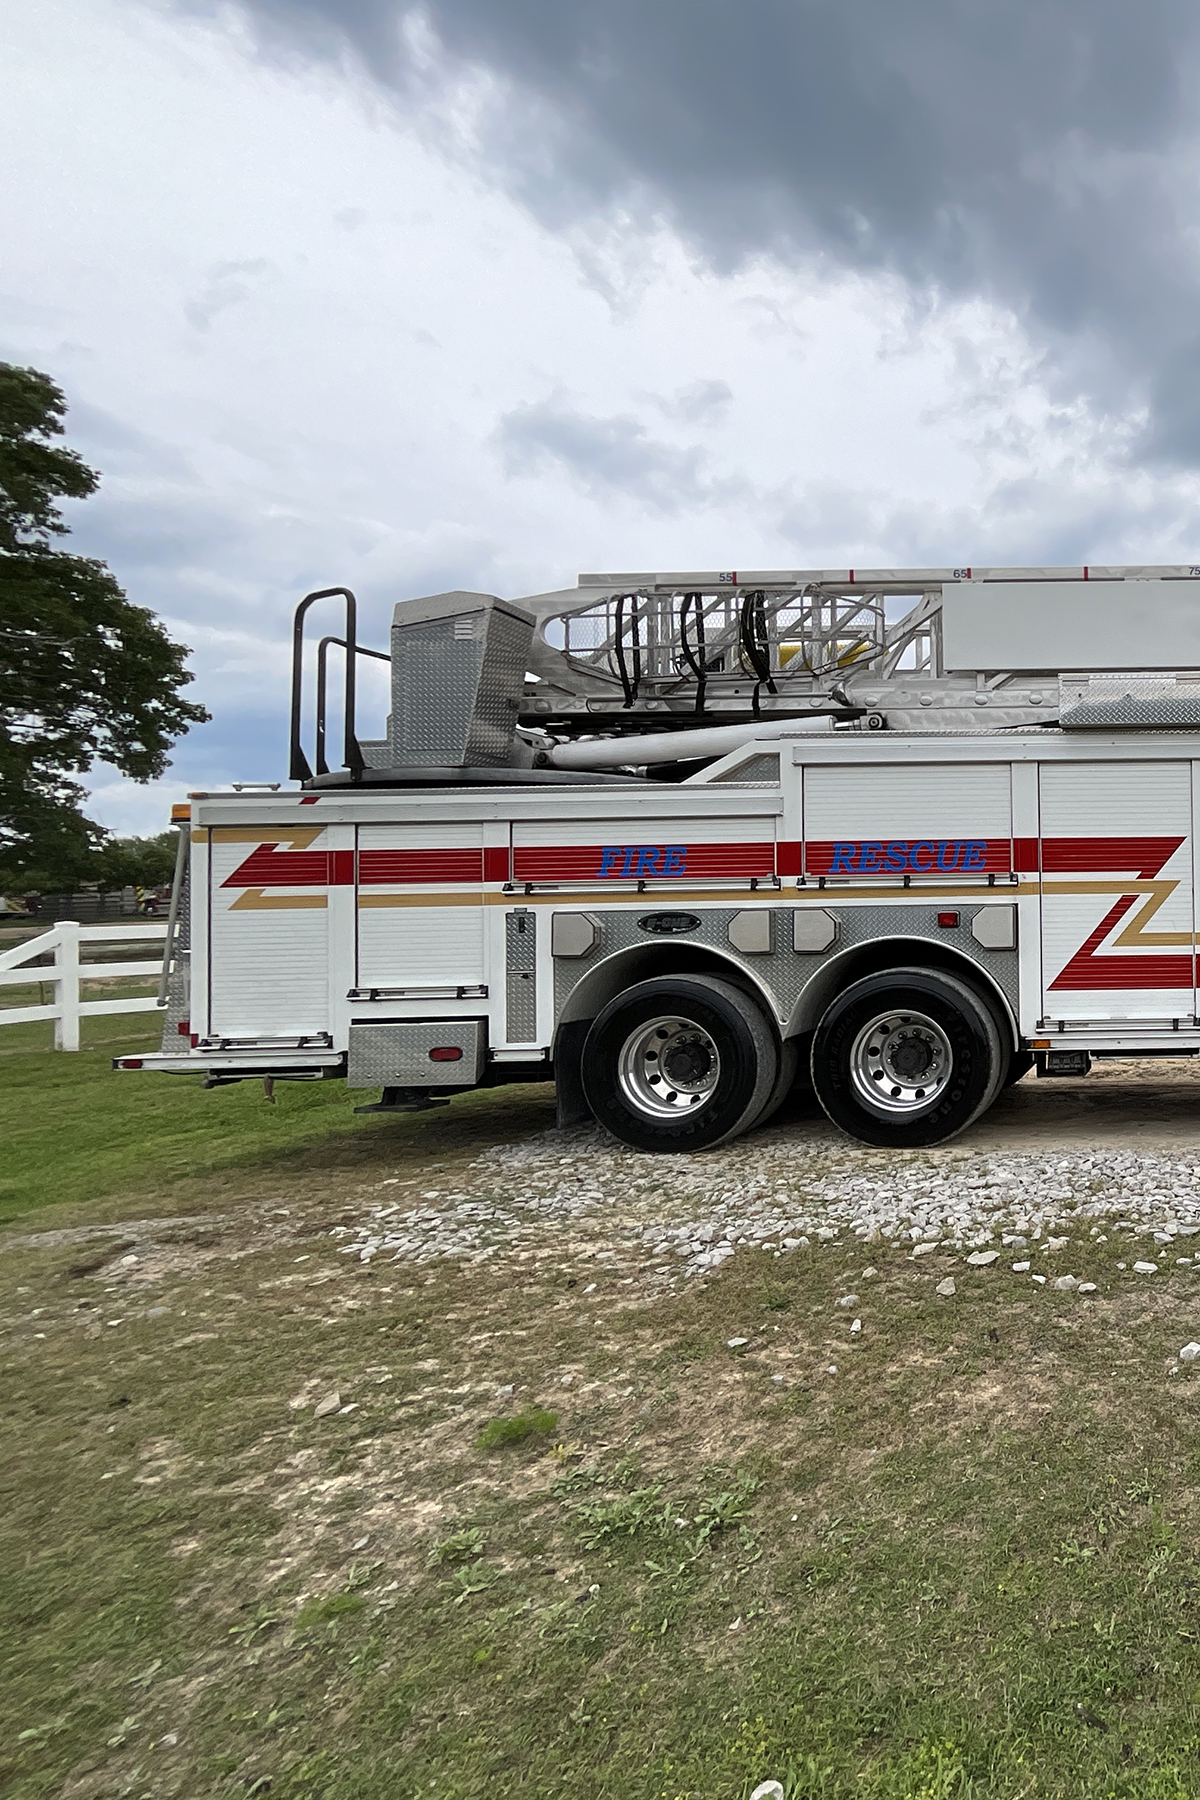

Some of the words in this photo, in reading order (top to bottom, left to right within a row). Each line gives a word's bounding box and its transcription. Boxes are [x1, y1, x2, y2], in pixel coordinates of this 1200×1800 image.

[953, 569, 967, 579] 65
[1188, 566, 1200, 576] 75
[718, 572, 733, 582] 55
[597, 846, 688, 878] FIRE
[828, 841, 988, 873] RESCUE
